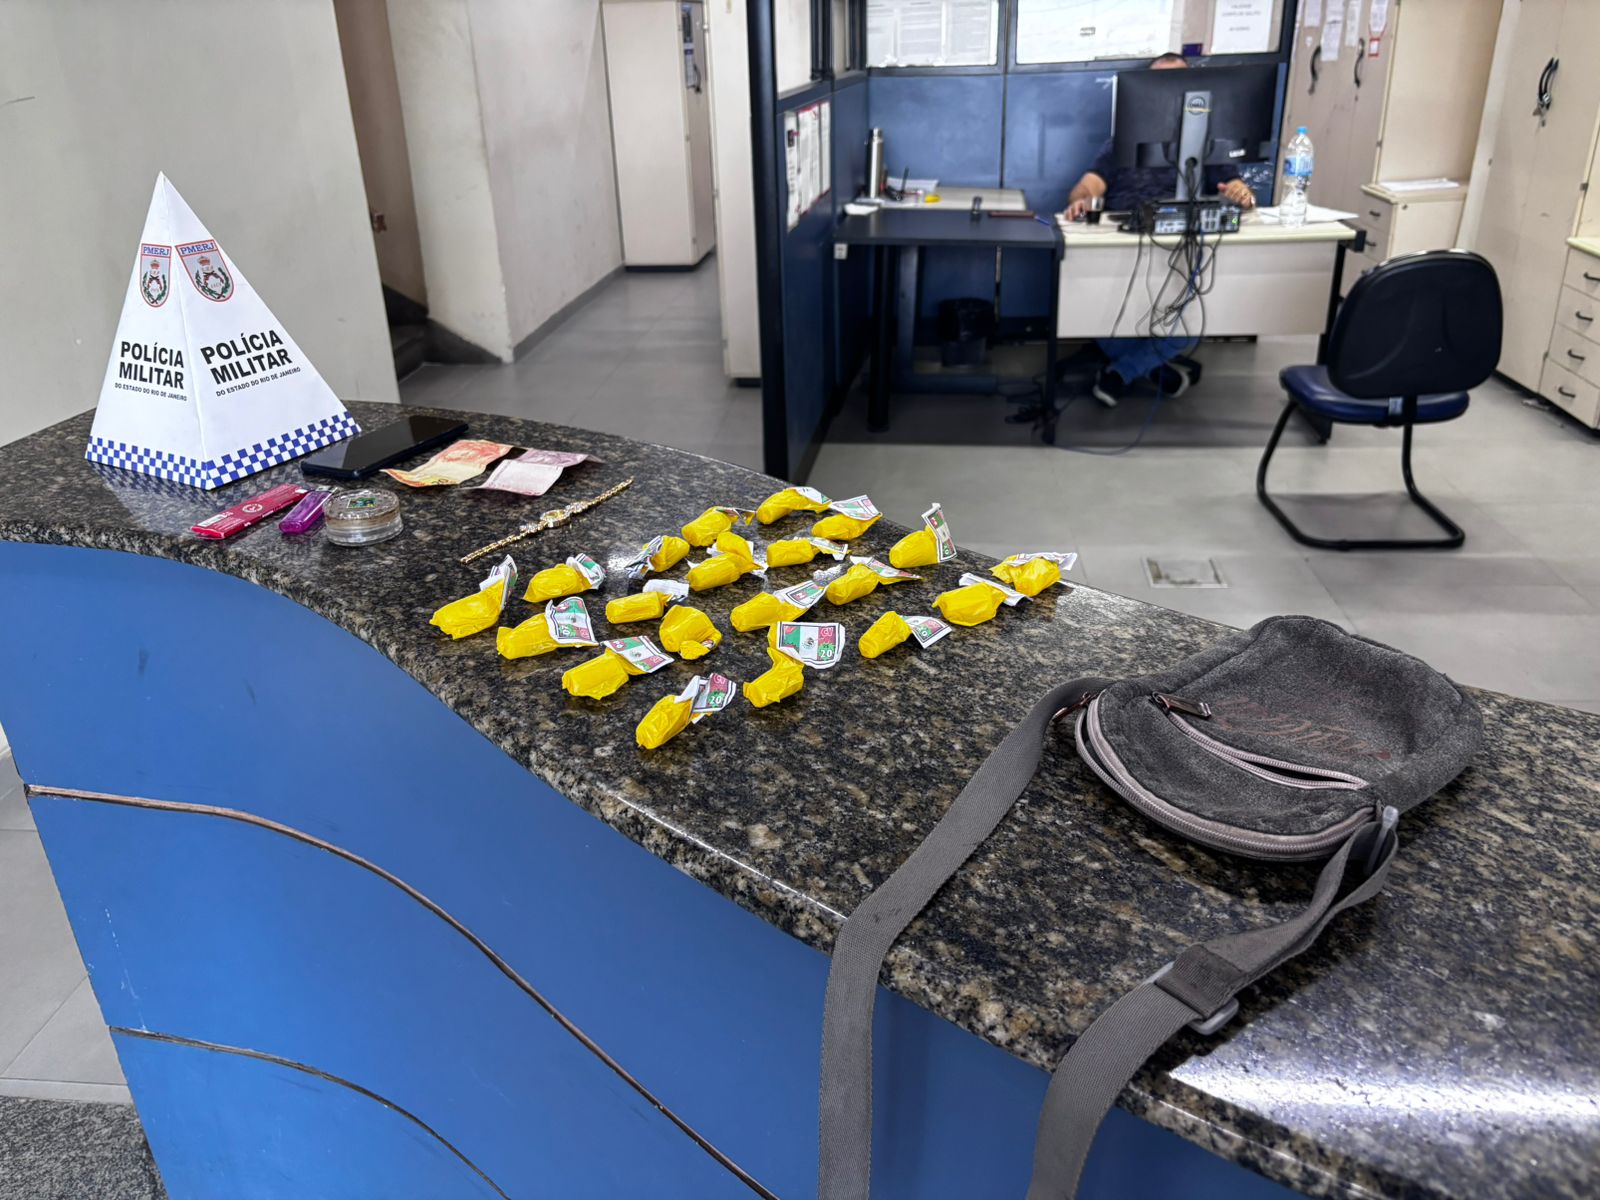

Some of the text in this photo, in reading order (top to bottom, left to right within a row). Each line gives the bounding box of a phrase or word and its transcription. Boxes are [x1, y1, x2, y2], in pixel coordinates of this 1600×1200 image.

[143, 246, 170, 256] PMERJ
[180, 242, 214, 255] PMERJ
[120, 341, 184, 368] POLÍCIA
[200, 329, 284, 365] POLÍCIA
[119, 361, 184, 390] MILITAR
[210, 348, 293, 385] MILITAR
[215, 389, 226, 397] DO
[226, 382, 250, 394] ESTADO
[279, 366, 301, 378] JANEIRO
[122, 384, 142, 393] ESTADO
[168, 392, 188, 402] JANEIRO
[820, 649, 833, 658] 20
[709, 695, 722, 704] 20
